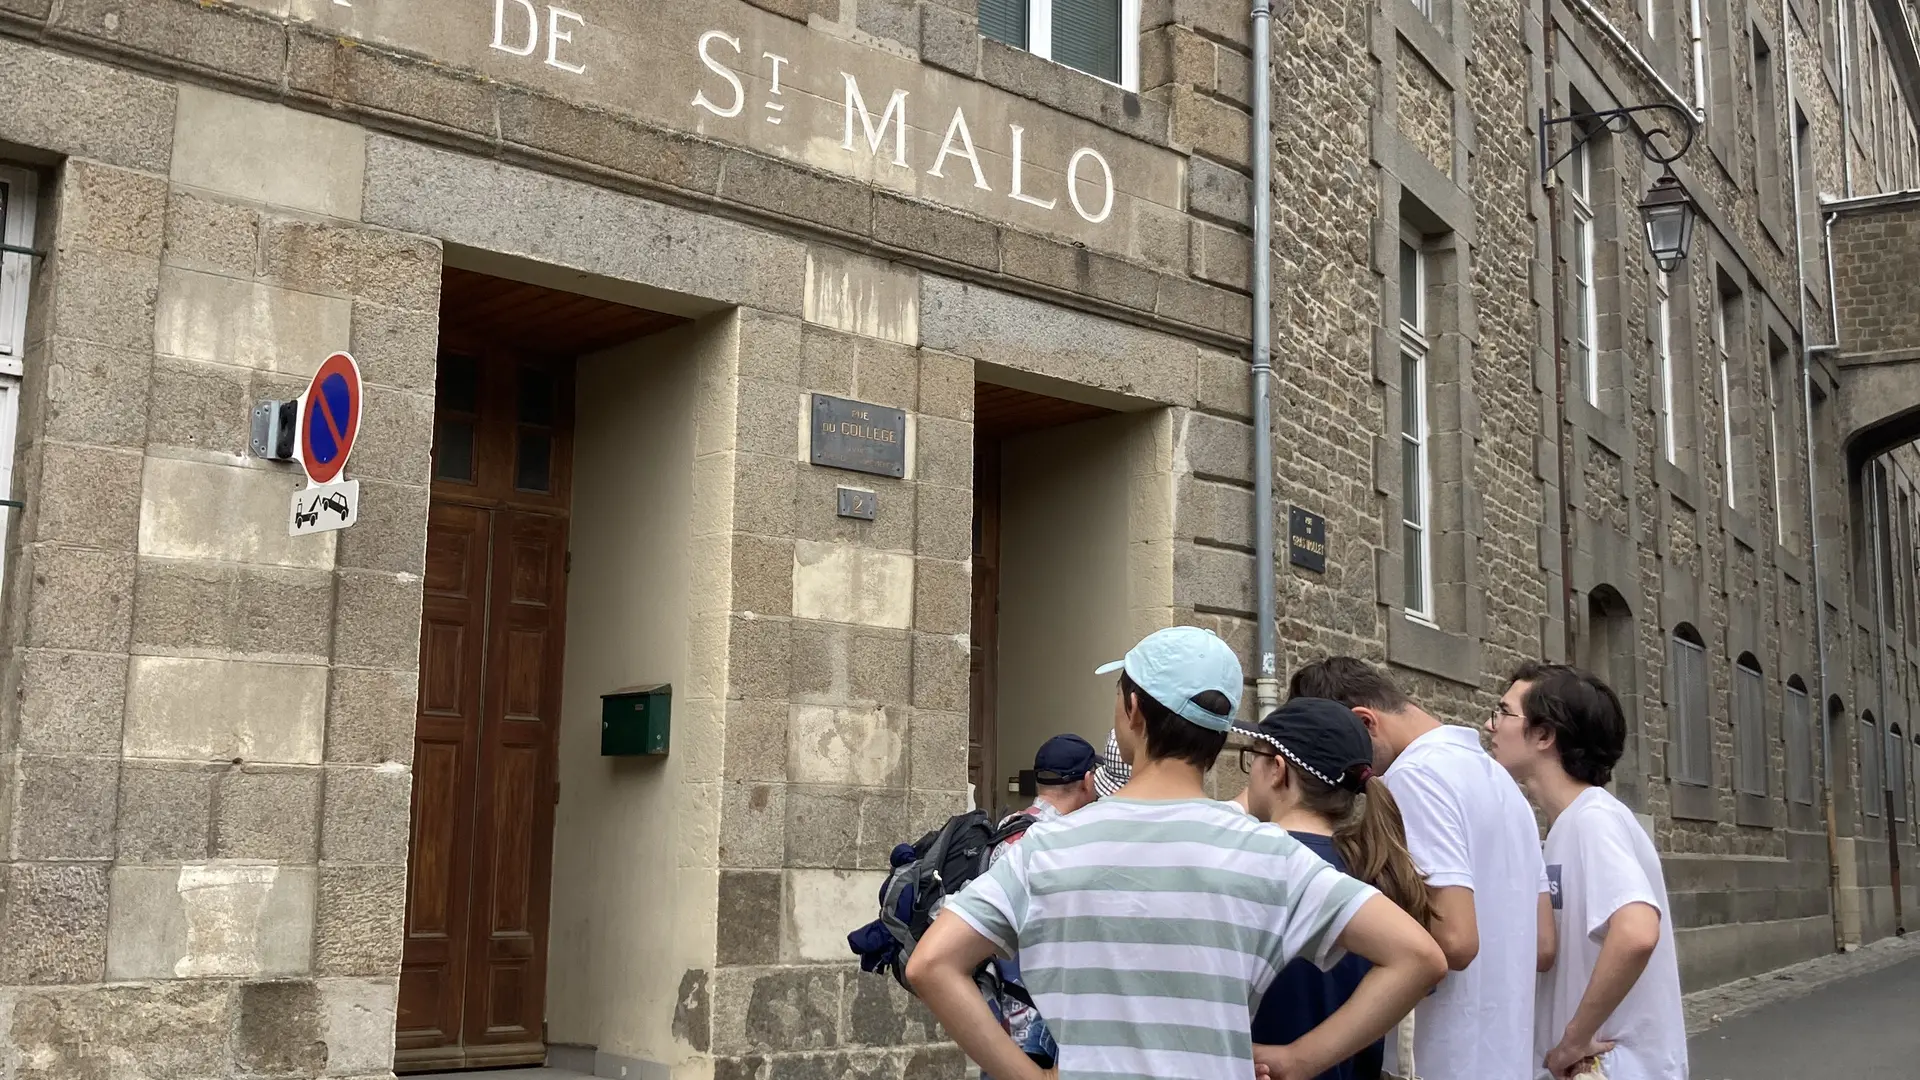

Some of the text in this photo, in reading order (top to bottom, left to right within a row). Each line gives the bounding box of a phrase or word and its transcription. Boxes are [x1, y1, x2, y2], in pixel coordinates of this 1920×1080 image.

[489, 0, 586, 75] DE
[840, 71, 1114, 224] MALO
[841, 422, 896, 443] COLLEGE
[853, 495, 863, 514] 2
